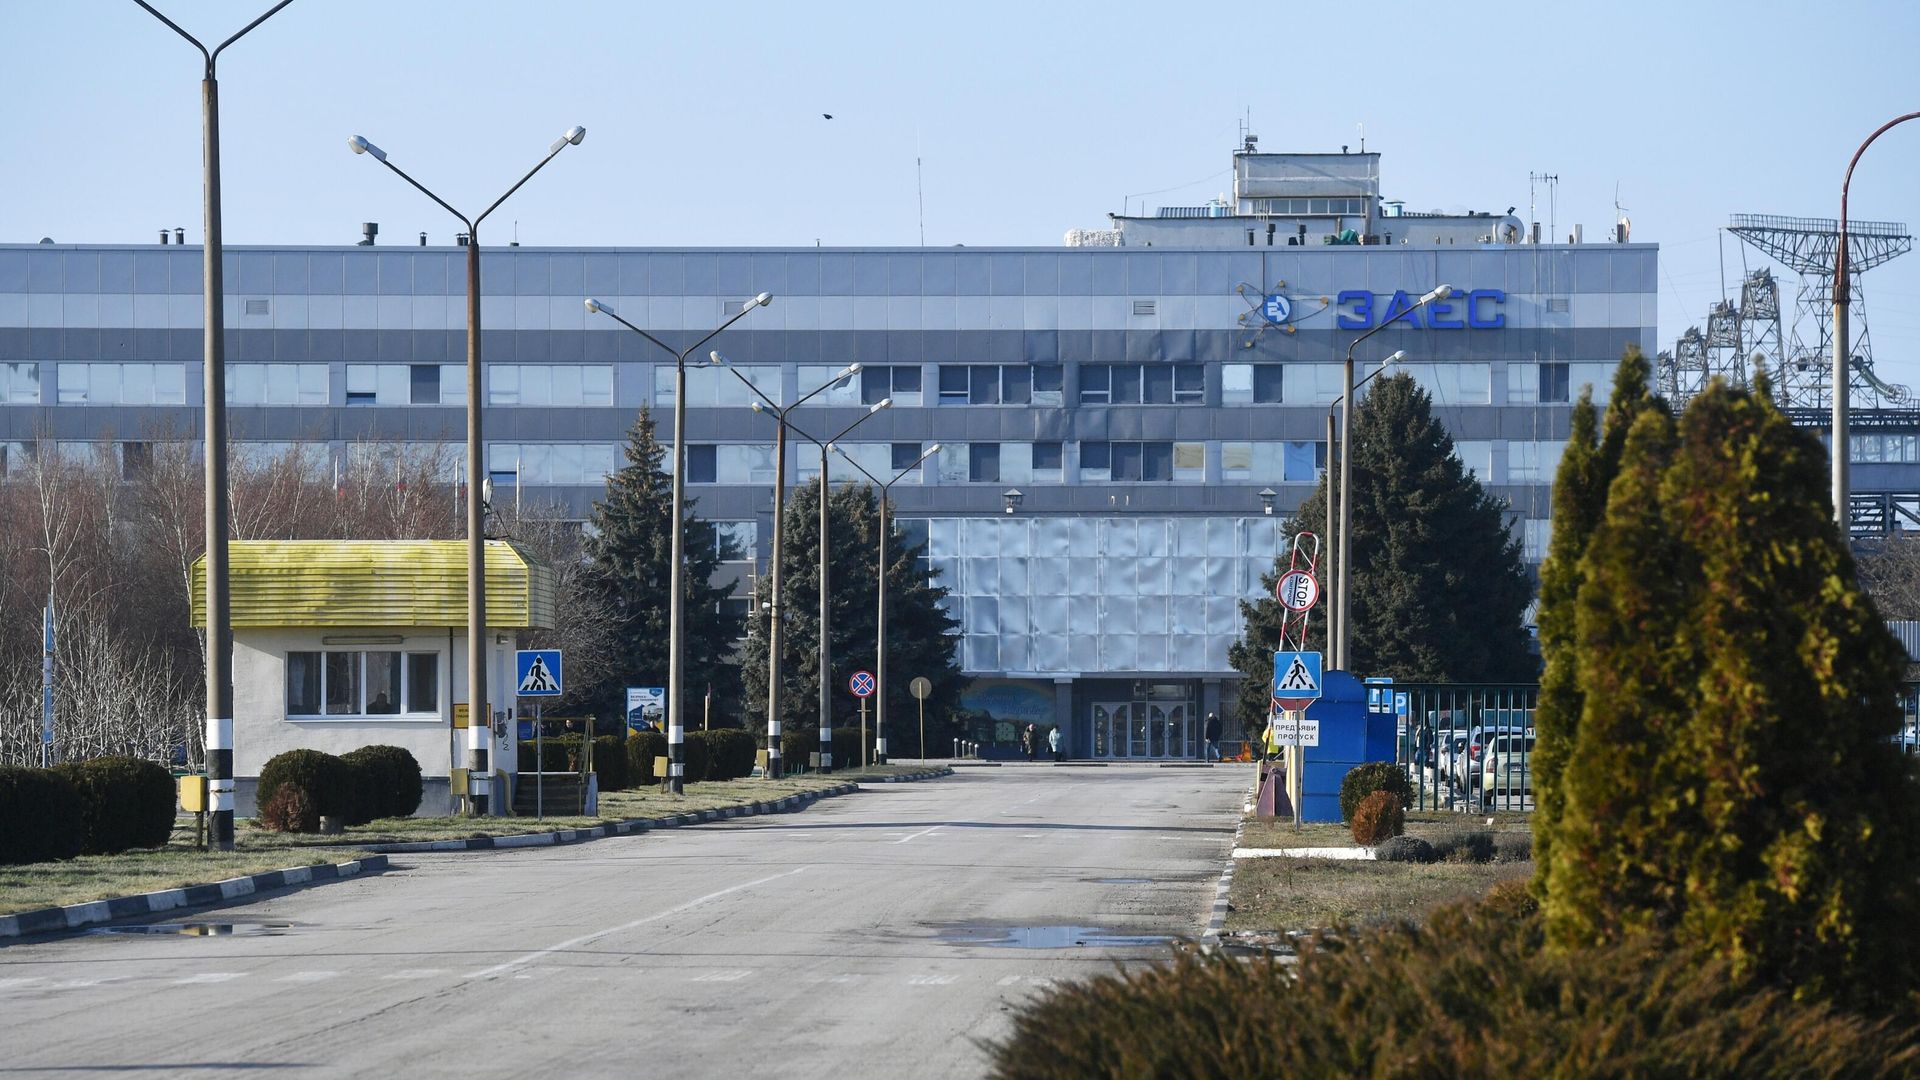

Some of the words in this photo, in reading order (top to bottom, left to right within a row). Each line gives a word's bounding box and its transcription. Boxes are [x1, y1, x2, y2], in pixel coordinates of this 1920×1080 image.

[1337, 289, 1505, 329] ЗАЕС
[1296, 576, 1309, 607] STOP
[1395, 695, 1407, 713] P
